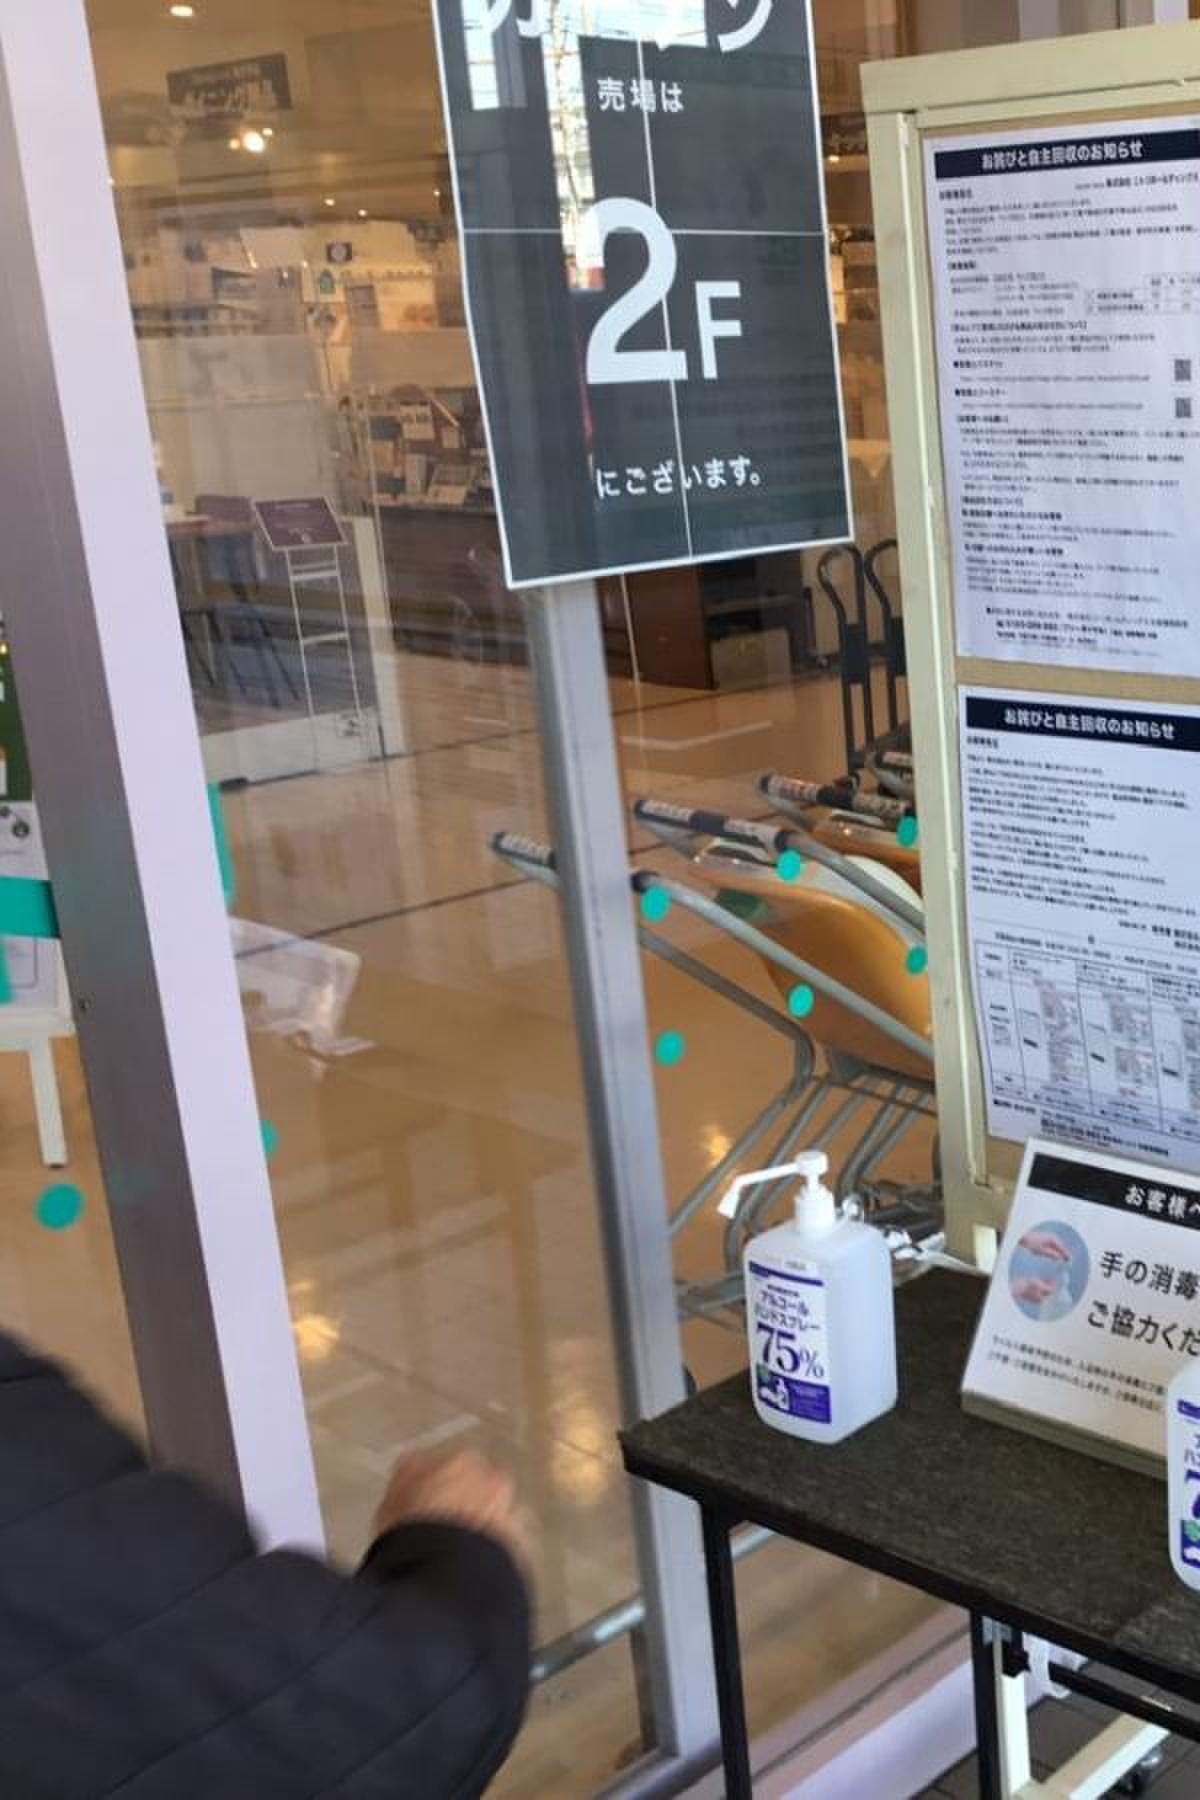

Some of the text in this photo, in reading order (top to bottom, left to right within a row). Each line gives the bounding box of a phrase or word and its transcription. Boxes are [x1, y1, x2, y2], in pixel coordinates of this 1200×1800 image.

[597, 78, 685, 114] 売場は
[586, 198, 742, 385] 2F
[596, 457, 761, 499] にございます。
[756, 1321, 825, 1378] 75%
